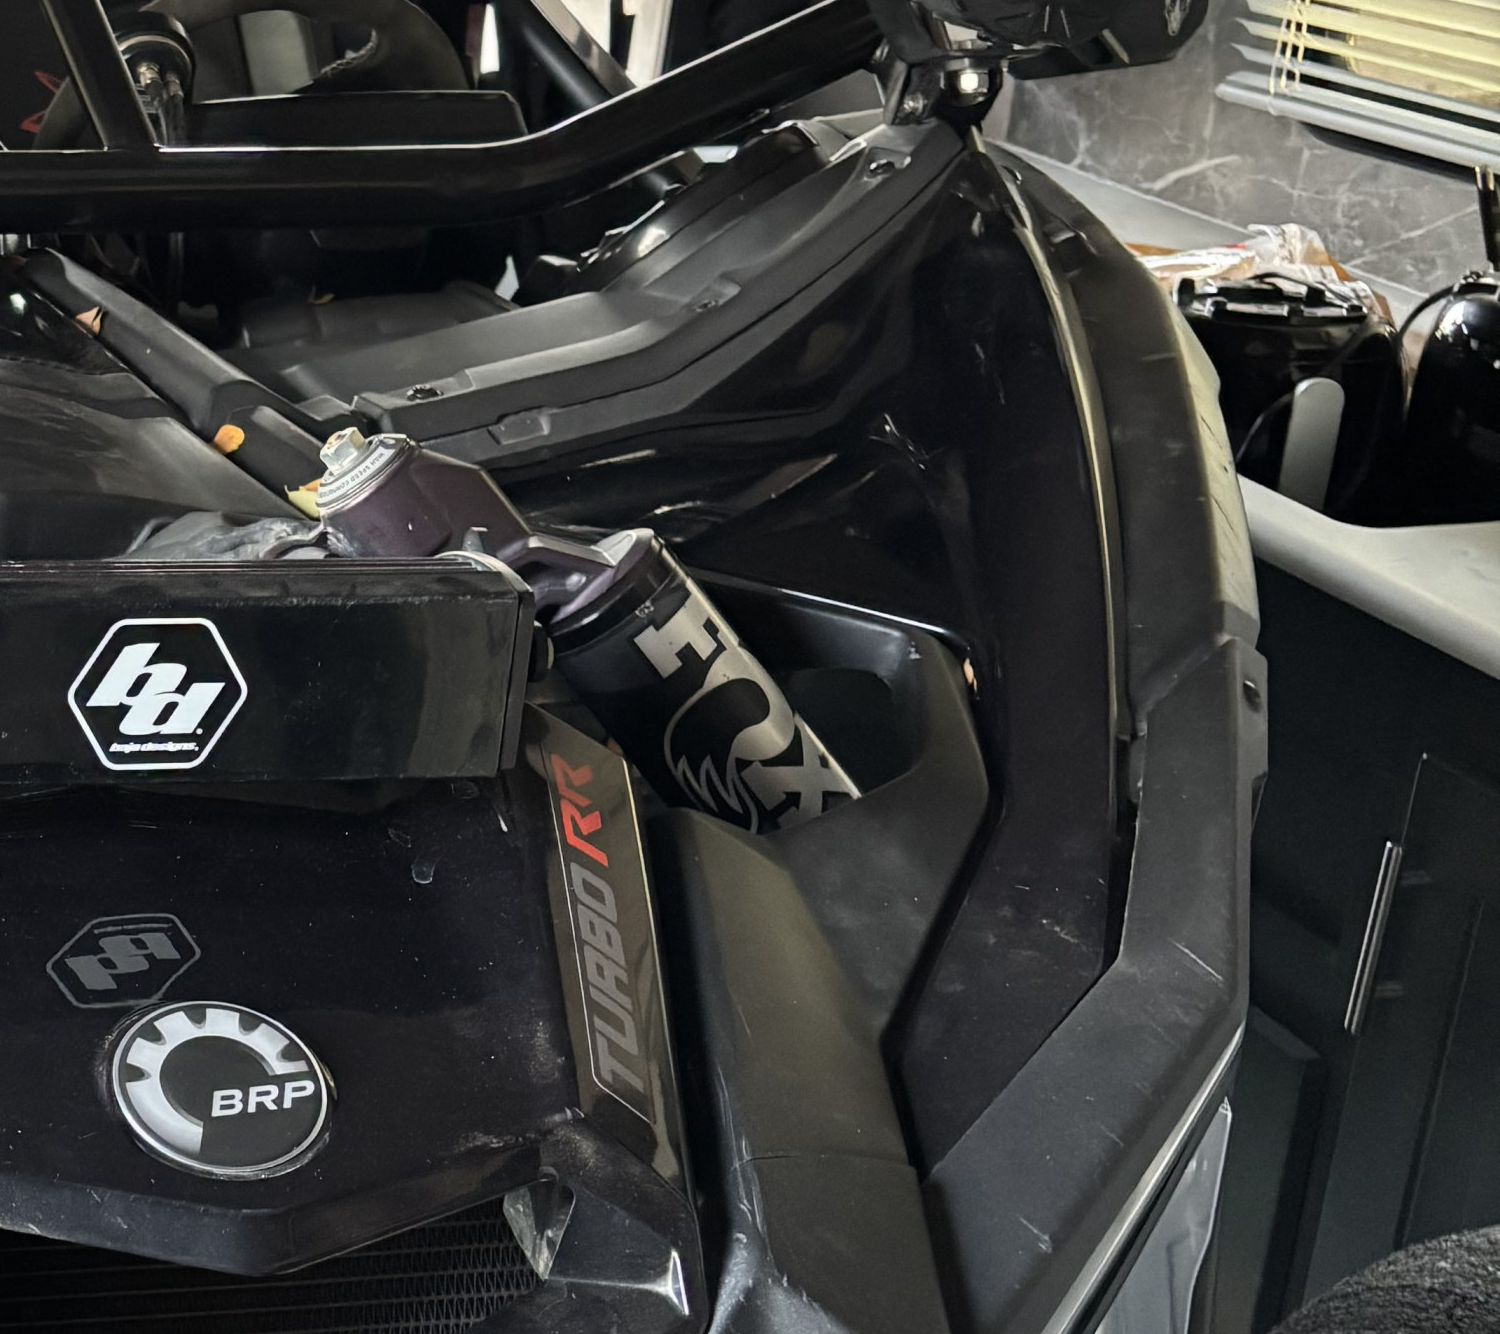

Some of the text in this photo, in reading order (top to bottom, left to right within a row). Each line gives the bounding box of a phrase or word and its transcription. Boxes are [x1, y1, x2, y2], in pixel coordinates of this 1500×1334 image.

[550, 753, 645, 1093] TURBO RR
[211, 1080, 316, 1117] BRP
